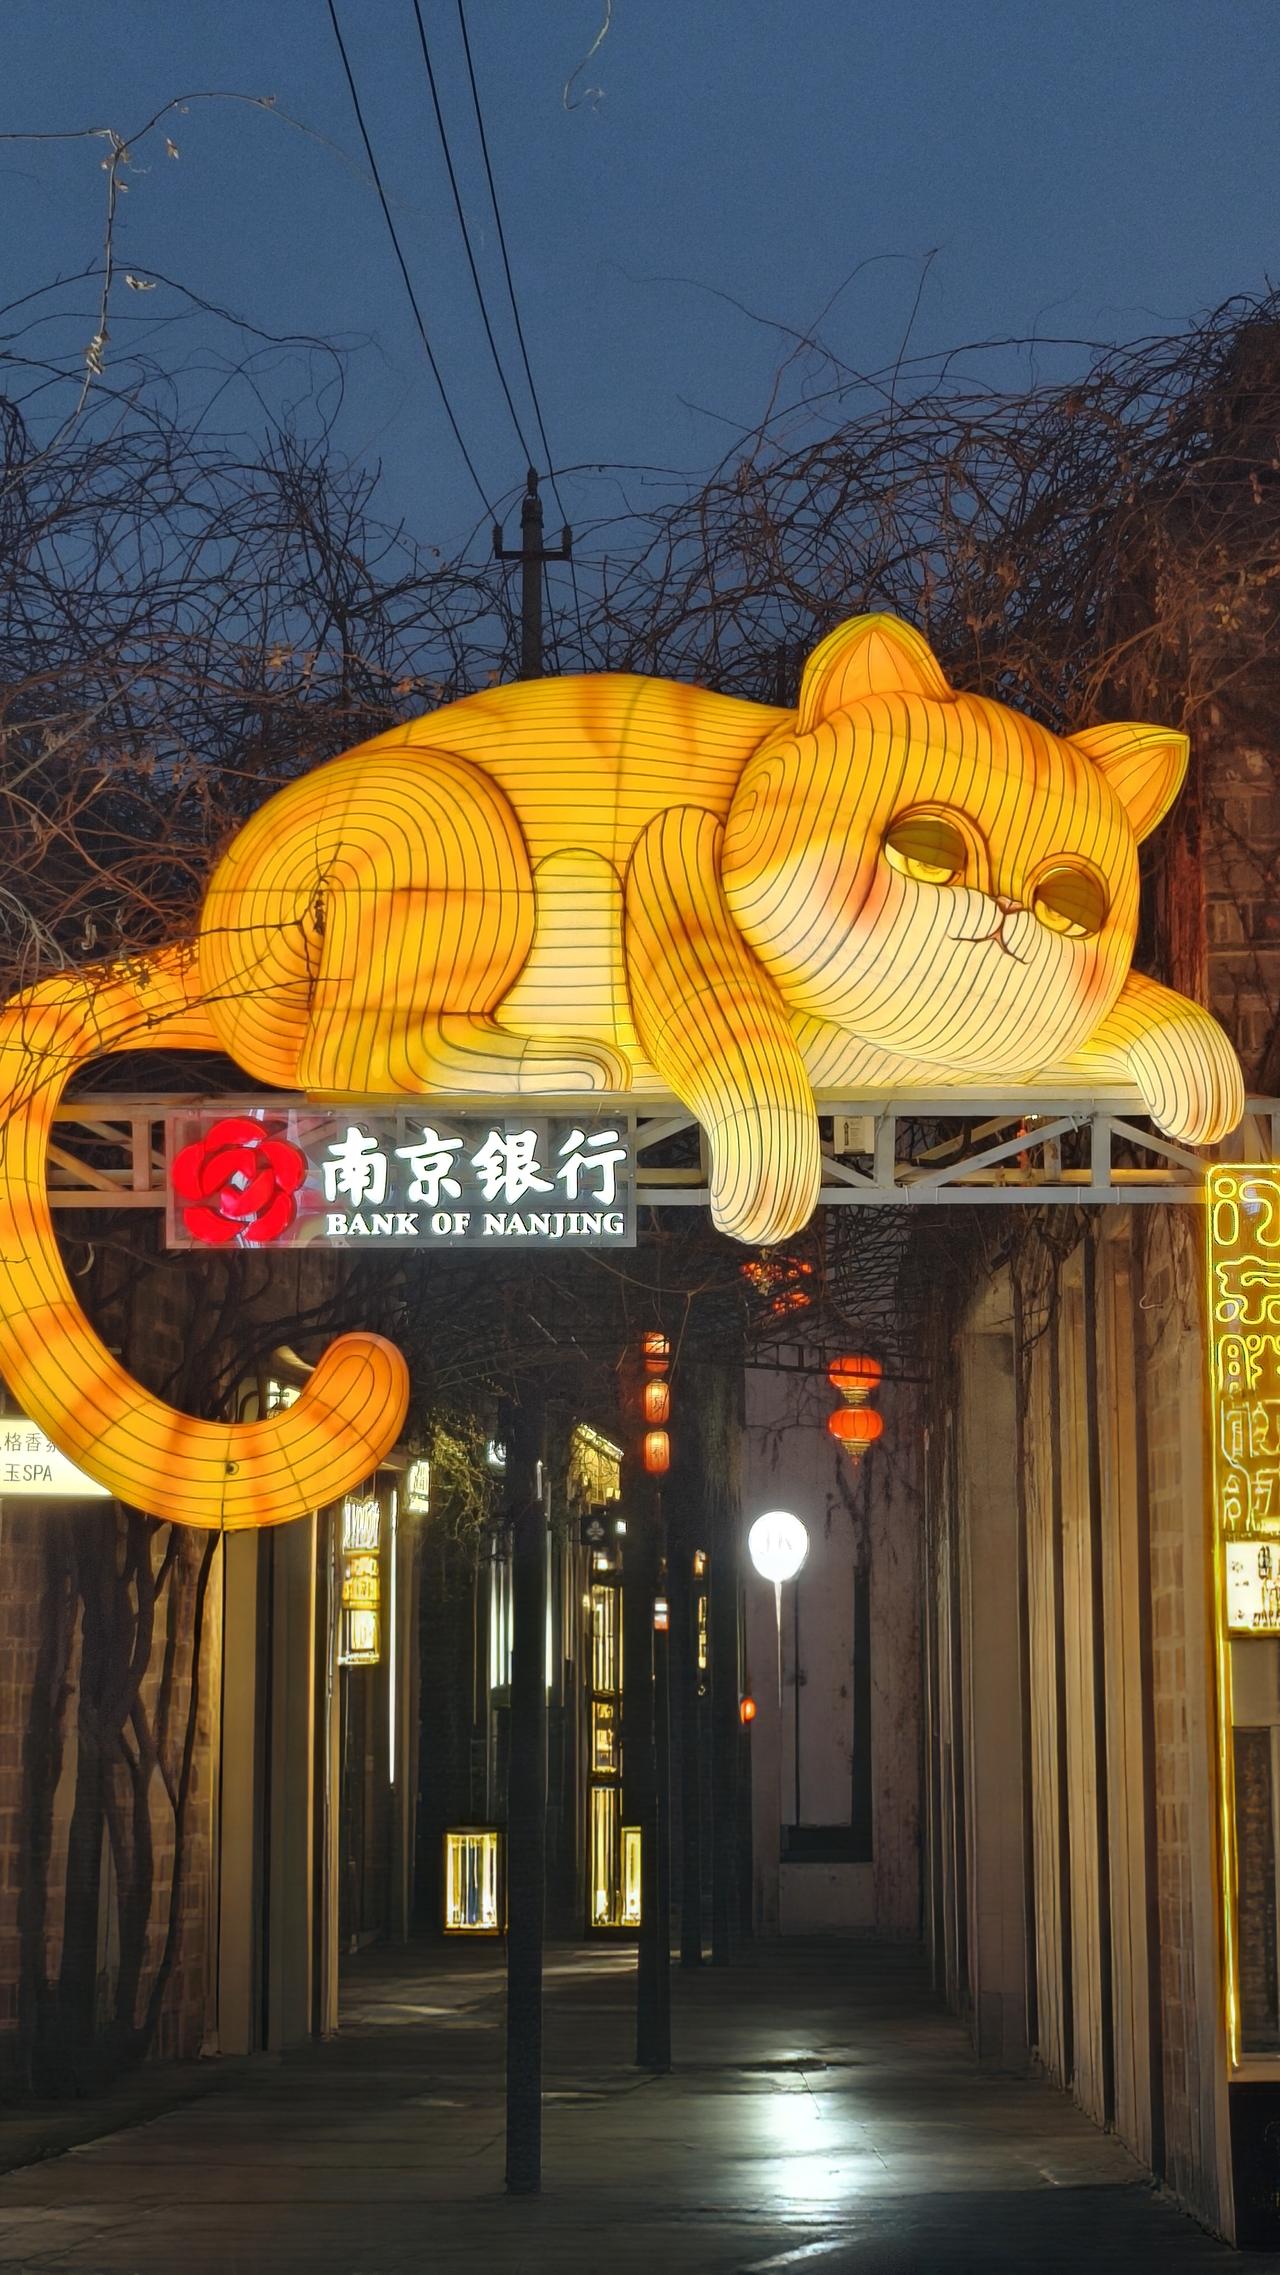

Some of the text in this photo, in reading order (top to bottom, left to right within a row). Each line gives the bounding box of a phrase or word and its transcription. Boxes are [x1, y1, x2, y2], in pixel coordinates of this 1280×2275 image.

[322, 1126, 628, 1207] 南京银行
[325, 1212, 625, 1238] BANK OF NANJING
[0, 1431, 56, 1453] 格香
